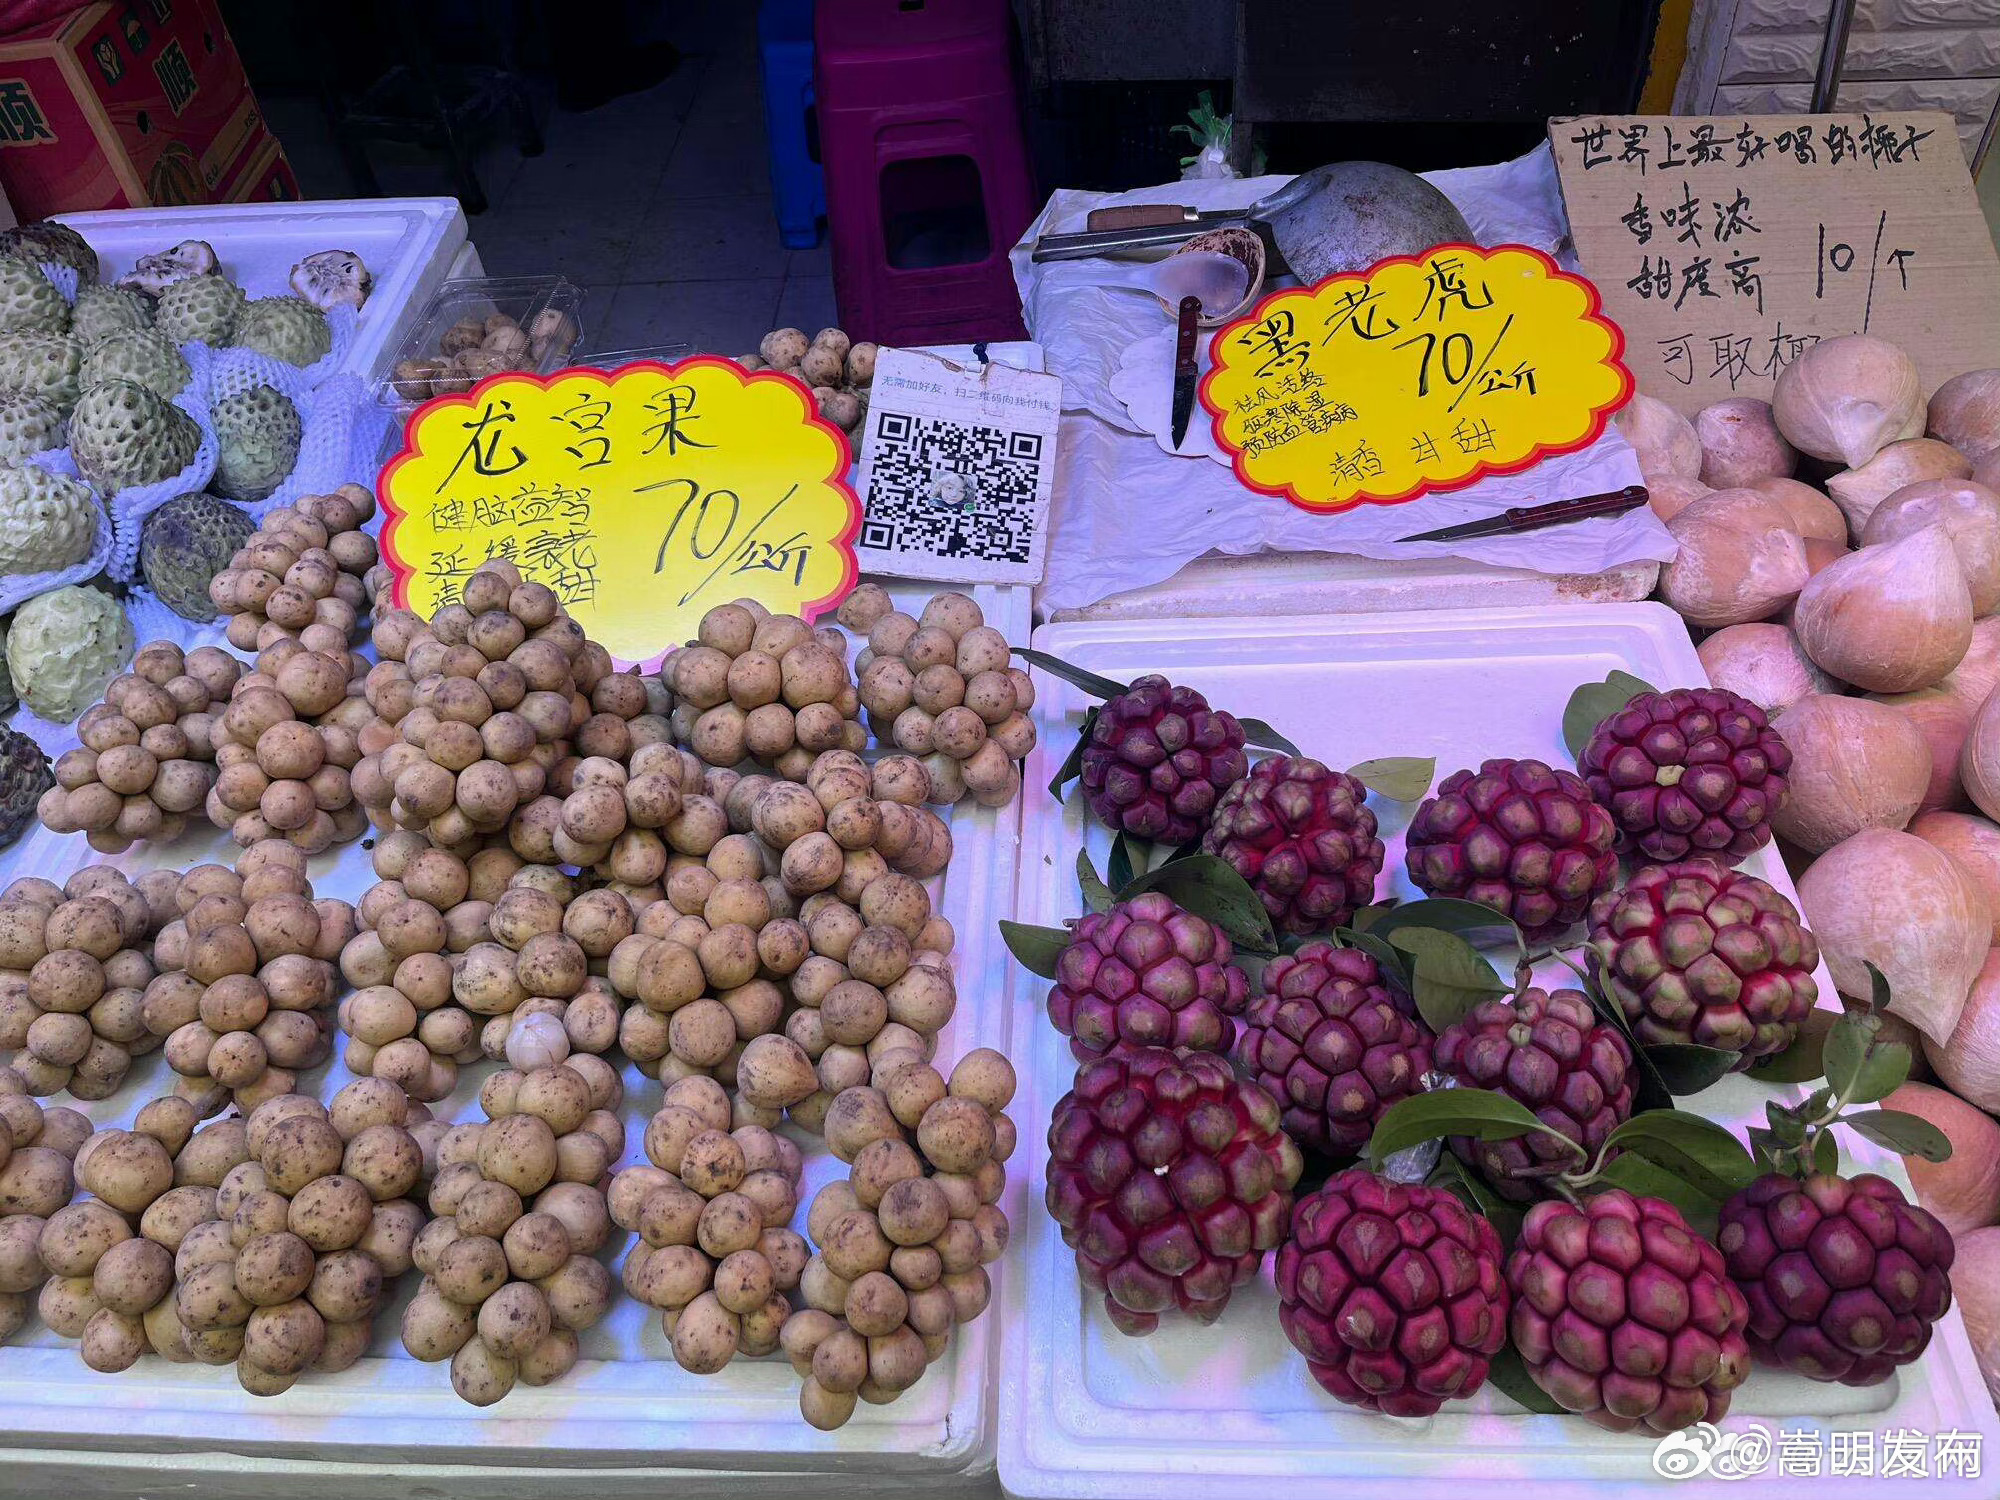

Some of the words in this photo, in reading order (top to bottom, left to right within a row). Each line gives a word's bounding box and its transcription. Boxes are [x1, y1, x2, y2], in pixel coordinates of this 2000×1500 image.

[1571, 113, 1935, 176] 世界上最好喝的椰子
[1621, 181, 1761, 248] 香味浓
[1627, 250, 1764, 316] 甜度高
[1816, 210, 1915, 335] 10/个
[1238, 257, 1494, 378] 黑老虎
[1392, 313, 1538, 413] 70/公斤
[436, 385, 718, 494] 龙宫果
[1241, 402, 1358, 459] 预防血管疾病
[423, 482, 591, 534] 健脑益智
[633, 478, 812, 607] 70/公斤
